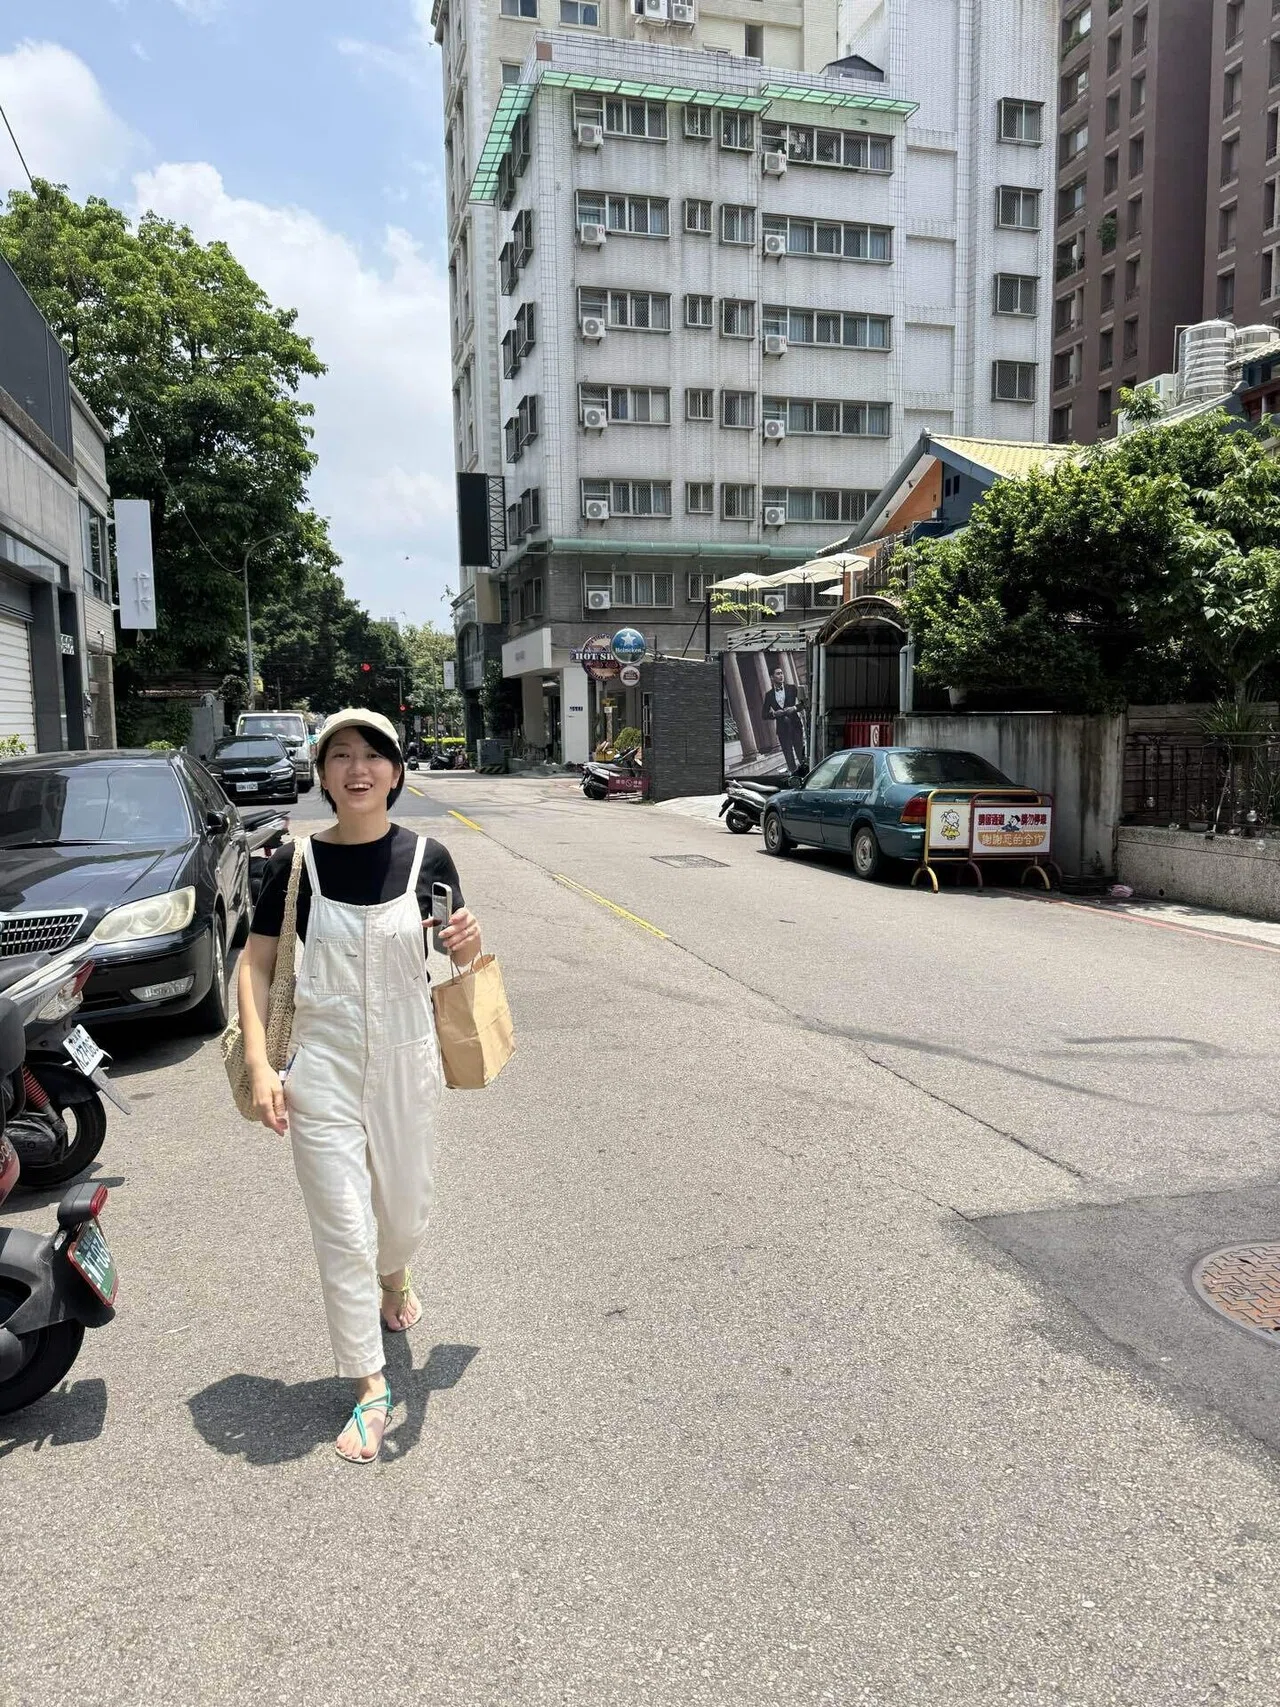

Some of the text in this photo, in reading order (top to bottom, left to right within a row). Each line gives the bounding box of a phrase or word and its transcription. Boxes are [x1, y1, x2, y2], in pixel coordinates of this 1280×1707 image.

[981, 834, 1044, 846] 謝謝您的合作
